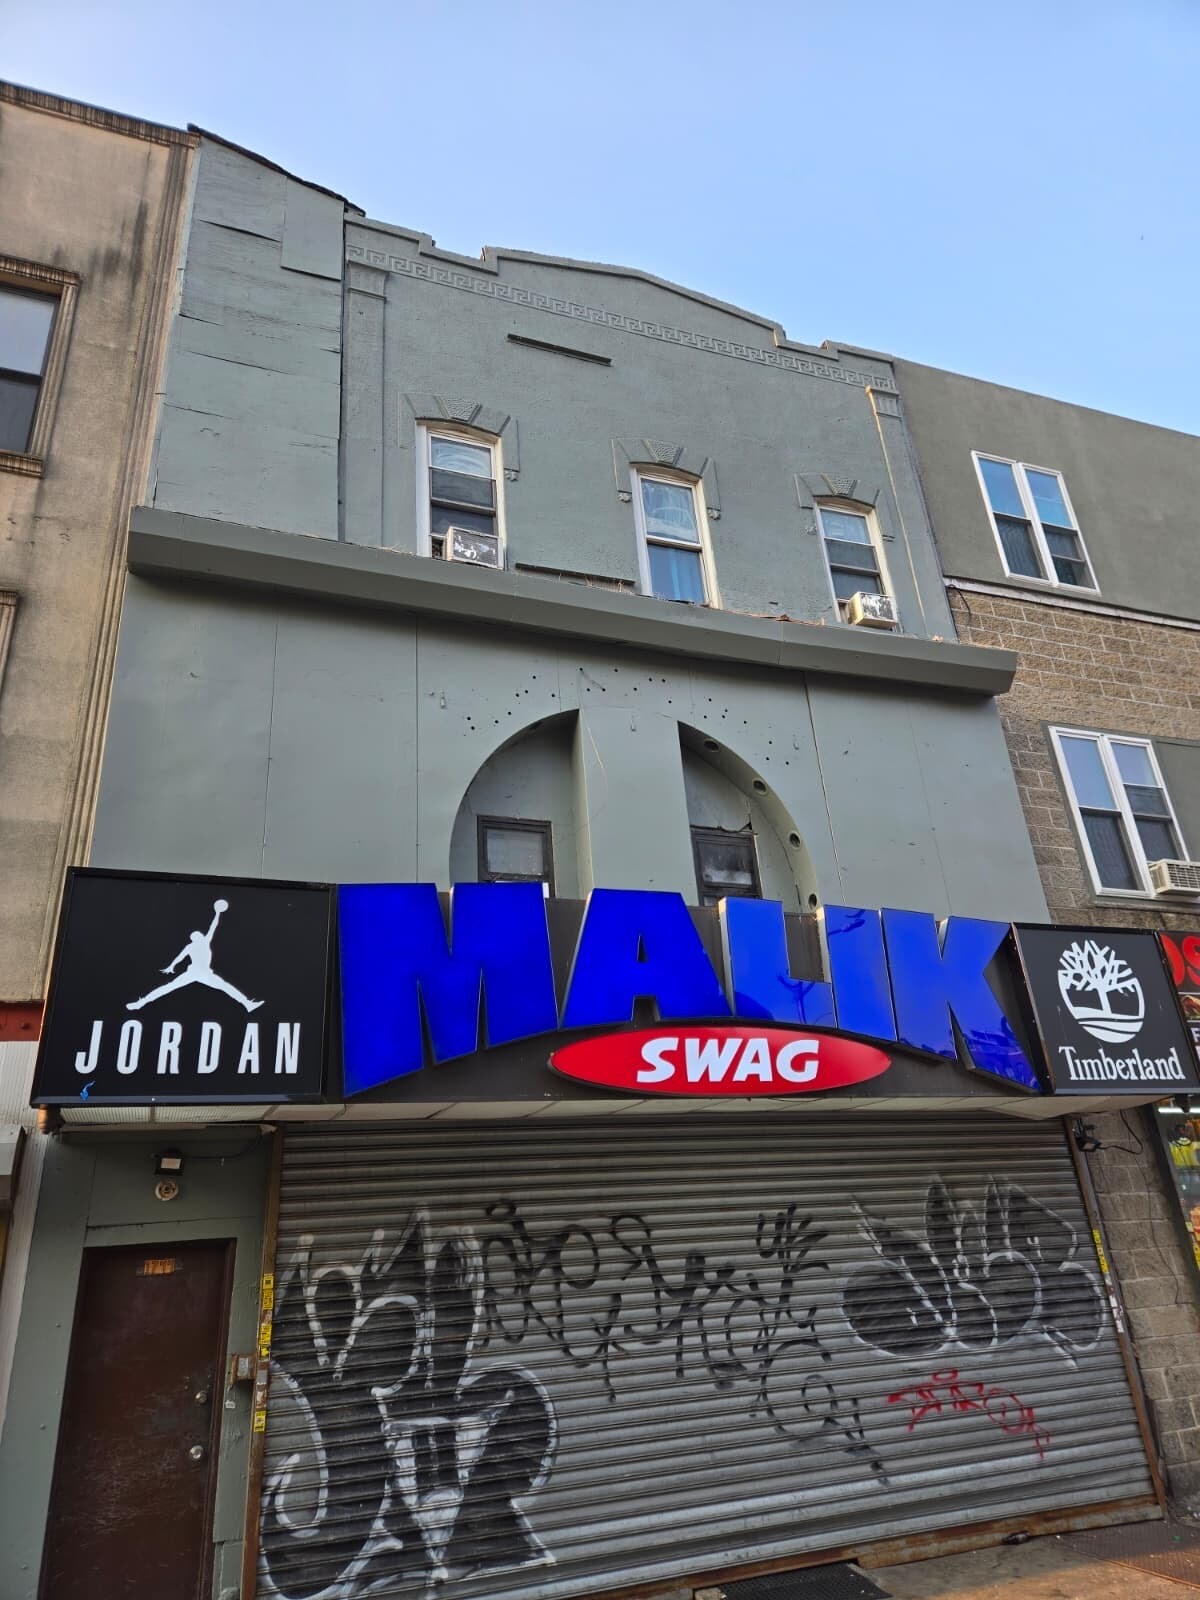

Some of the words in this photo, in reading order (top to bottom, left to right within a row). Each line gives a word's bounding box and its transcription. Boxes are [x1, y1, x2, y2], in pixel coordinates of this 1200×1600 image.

[338, 882, 1042, 1097] MALIK
[75, 1020, 301, 1075] JORDAN
[636, 1036, 819, 1084] SWAG
[1059, 1046, 1185, 1081] Timberland
